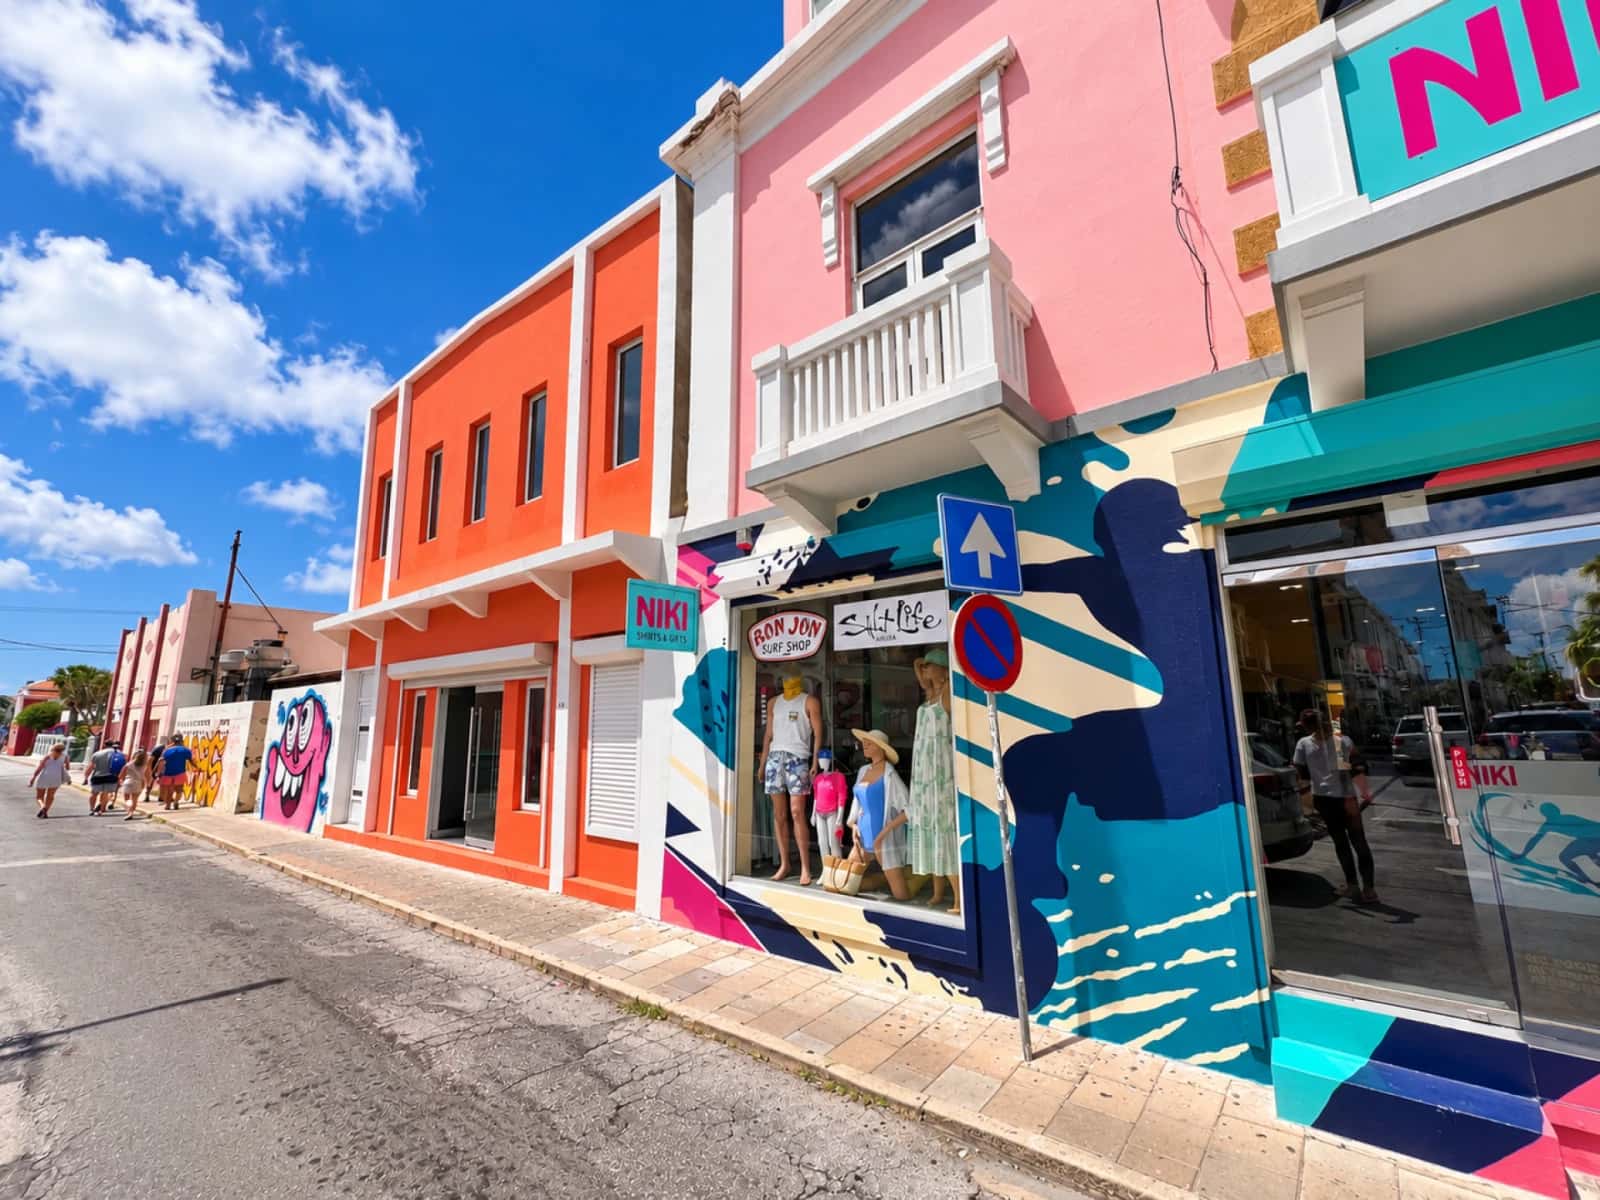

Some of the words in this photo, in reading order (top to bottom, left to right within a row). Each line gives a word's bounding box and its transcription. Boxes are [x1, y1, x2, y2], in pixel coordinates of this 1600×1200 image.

[1389, 0, 1600, 159] NI
[636, 595, 688, 631] NIKI
[897, 600, 942, 633] Life
[754, 617, 784, 646] RON
[788, 616, 821, 638] JON
[762, 642, 783, 655] SURF
[786, 640, 811, 652] SHOP
[1453, 750, 1467, 787] PUSH
